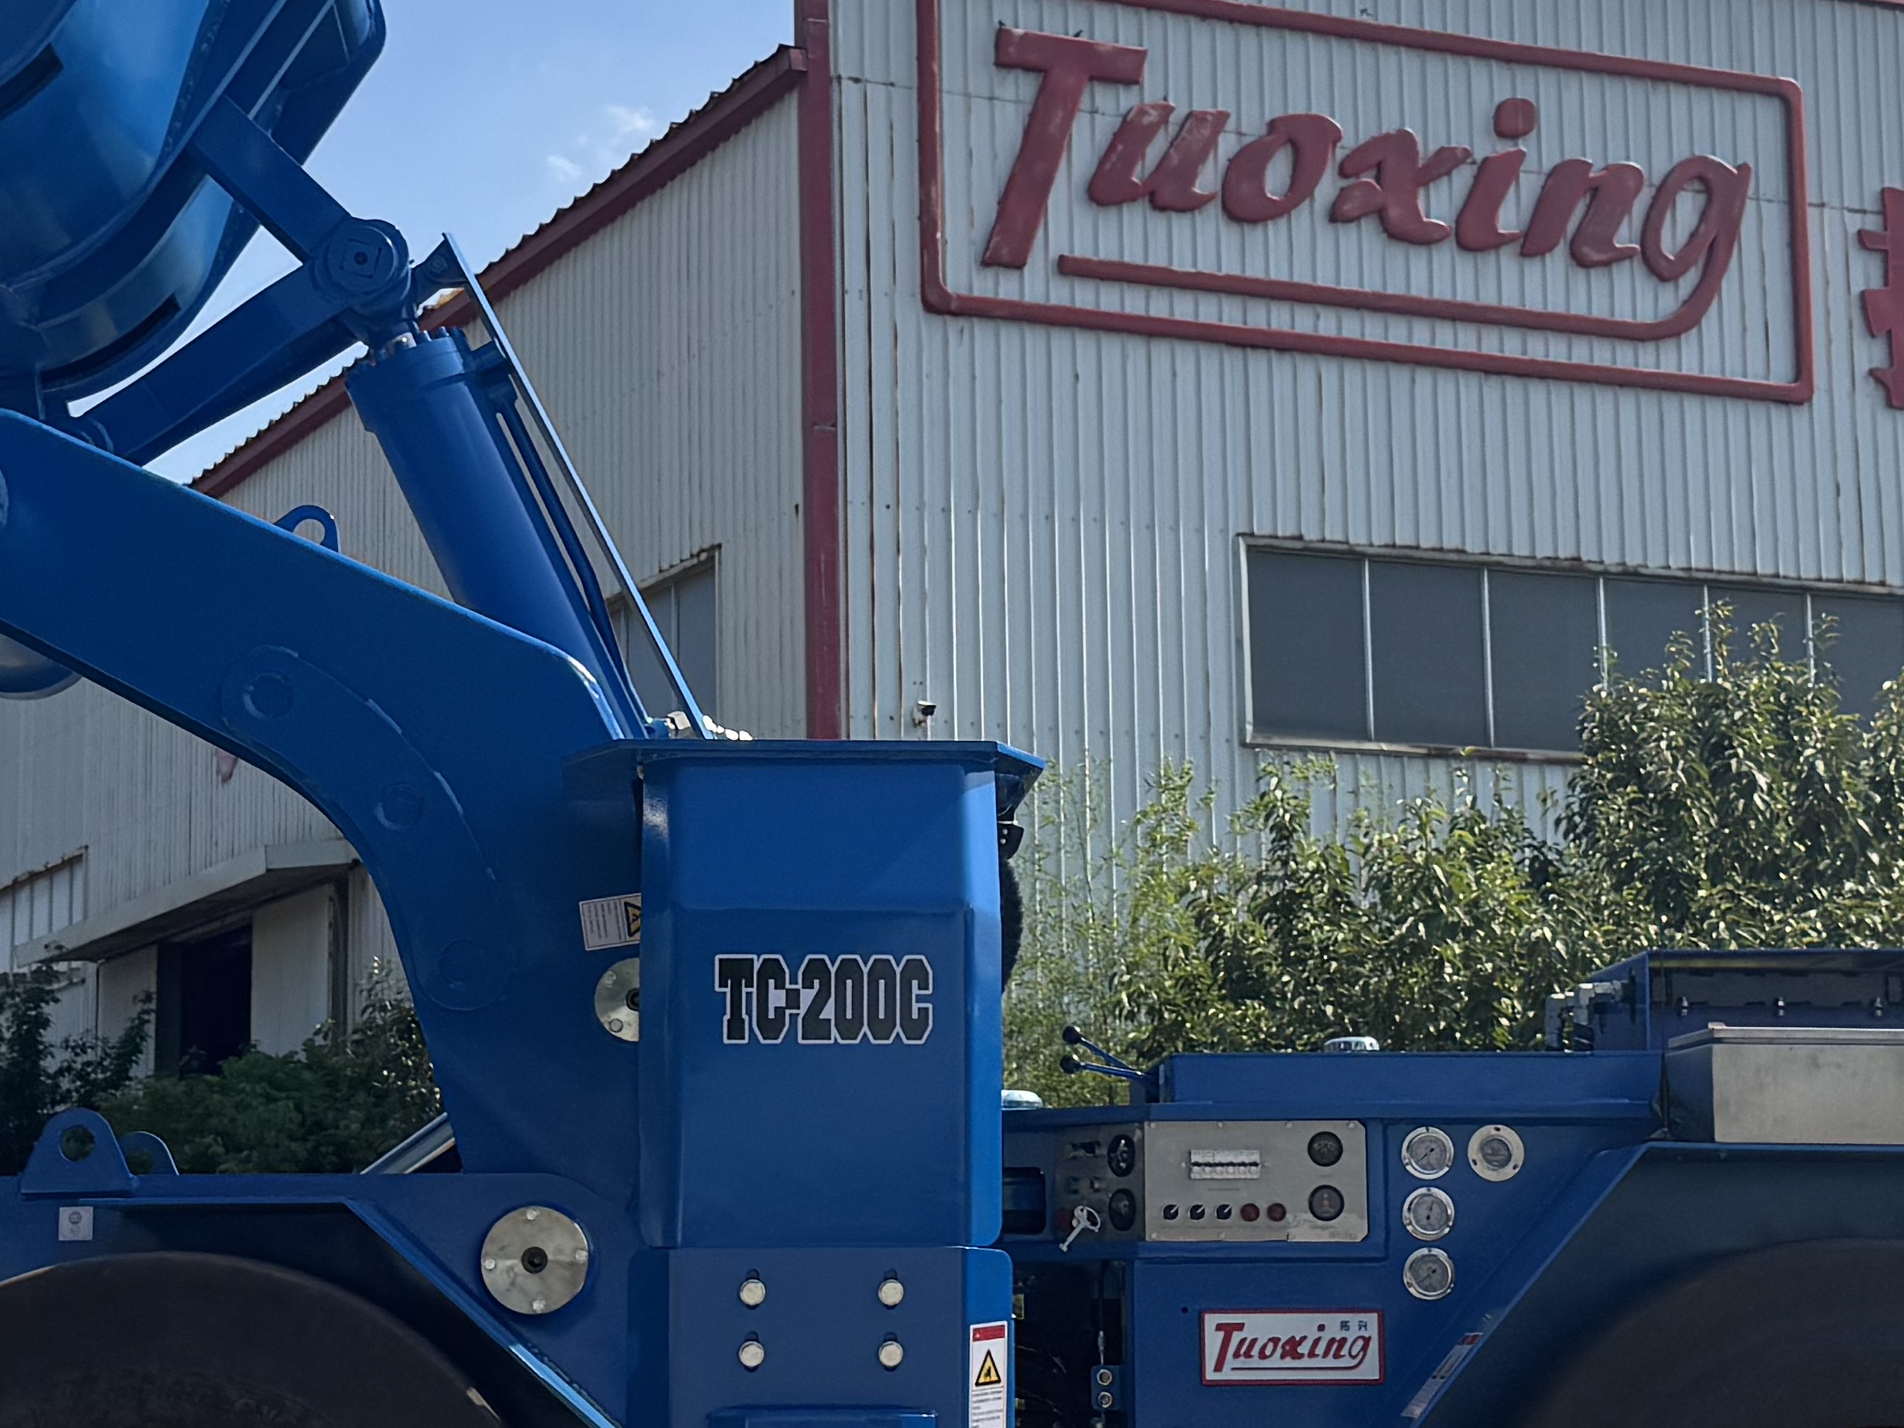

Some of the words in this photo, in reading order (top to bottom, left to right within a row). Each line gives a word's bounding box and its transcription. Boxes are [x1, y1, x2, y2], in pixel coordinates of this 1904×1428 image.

[981, 27, 1752, 340] Tuoxing
[715, 954, 933, 1044] TC-200C
[1212, 1322, 1372, 1373] Tuoxing
